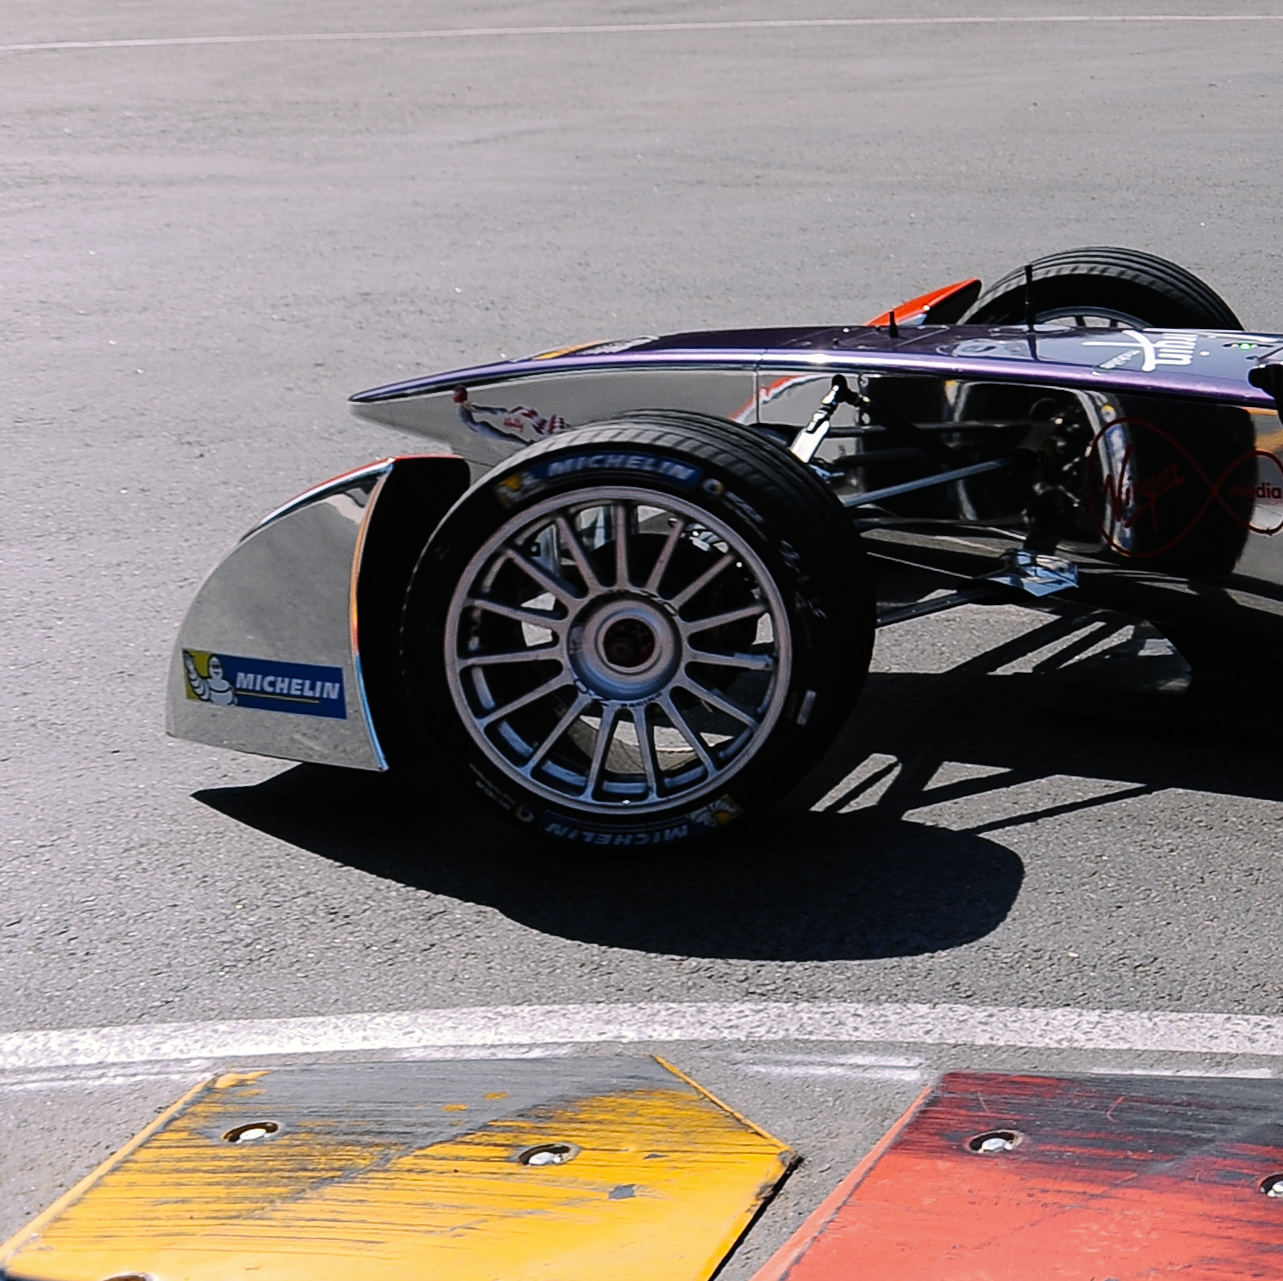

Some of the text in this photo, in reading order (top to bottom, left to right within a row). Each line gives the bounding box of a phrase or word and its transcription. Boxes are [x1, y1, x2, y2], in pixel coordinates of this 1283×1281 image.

[547, 454, 696, 481] MICHELIN
[1103, 444, 1188, 533] Virgin
[1229, 482, 1282, 500] media
[236, 672, 340, 700] MICHELIN
